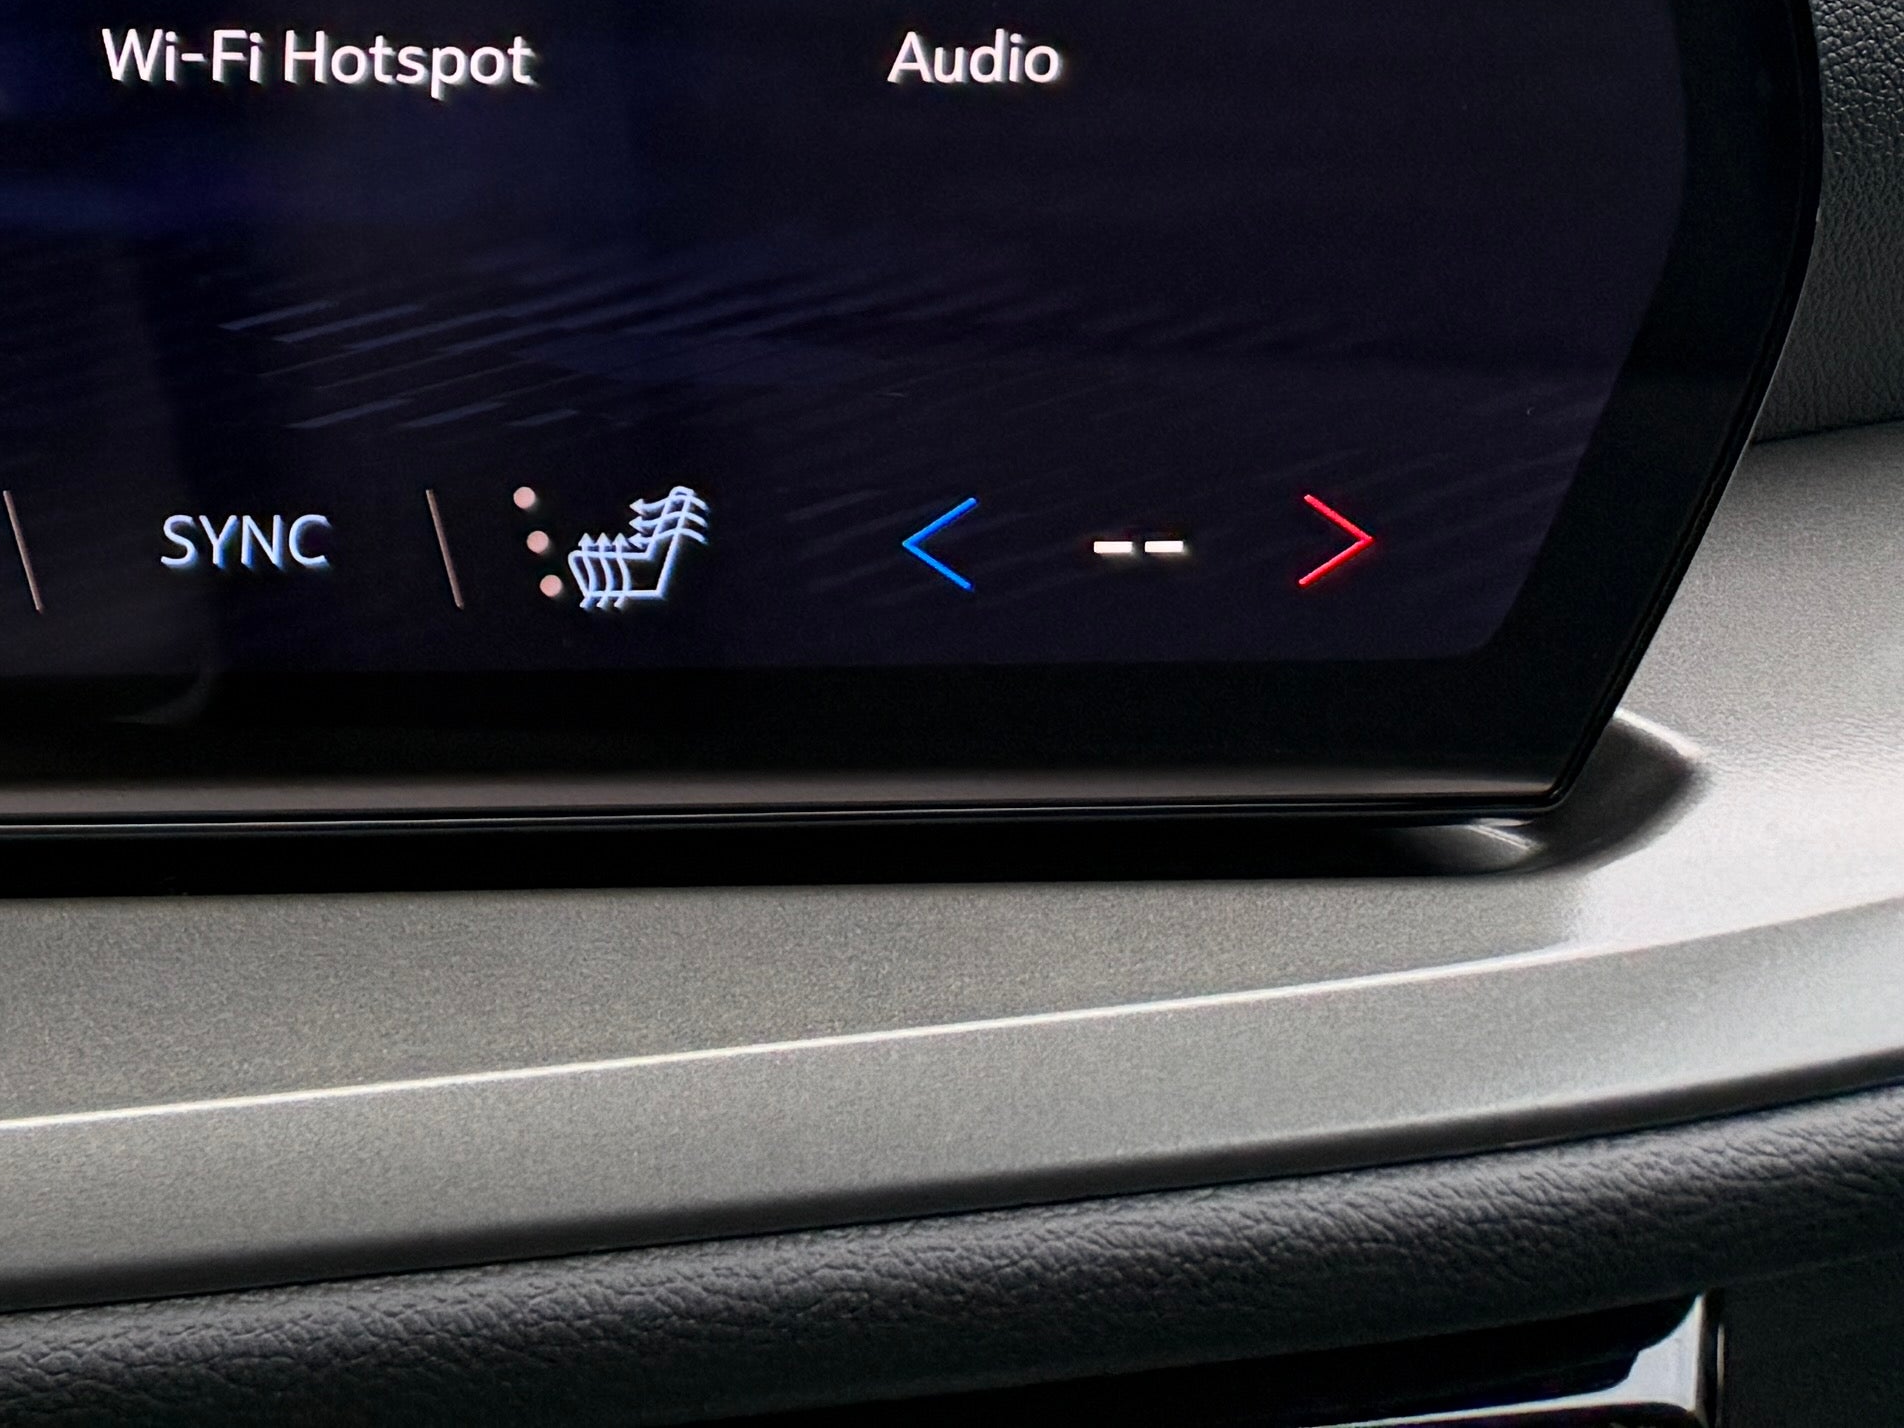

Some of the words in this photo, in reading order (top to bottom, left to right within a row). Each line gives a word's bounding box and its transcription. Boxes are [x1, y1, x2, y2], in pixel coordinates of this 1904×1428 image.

[100, 27, 265, 84] Wi-Fi
[283, 28, 536, 102] Hotspot
[886, 27, 1064, 85] Audio
[159, 513, 331, 570] SYNC
